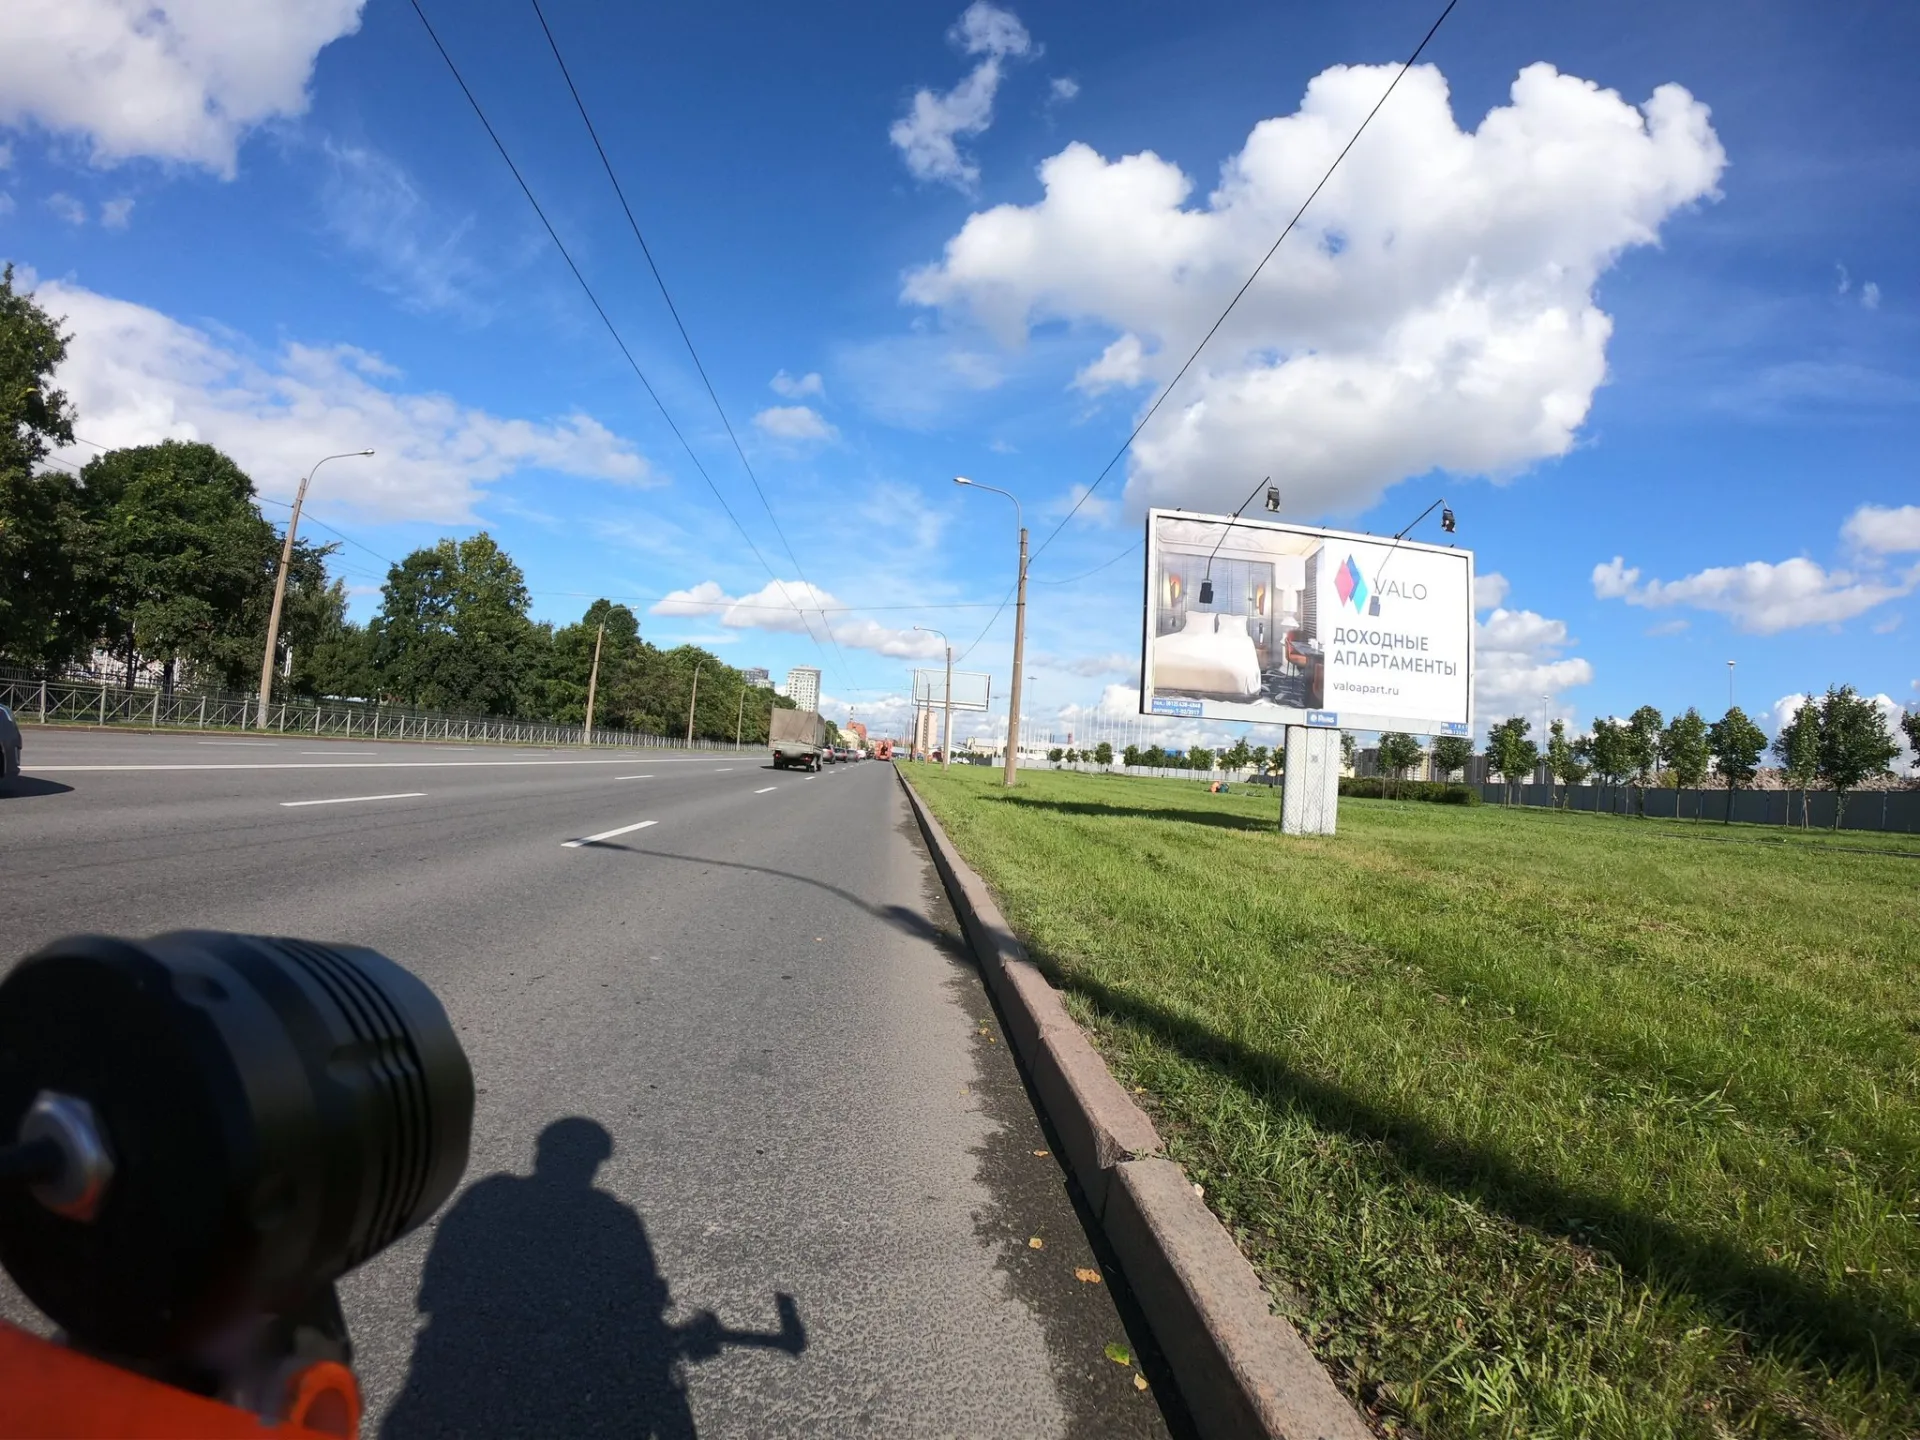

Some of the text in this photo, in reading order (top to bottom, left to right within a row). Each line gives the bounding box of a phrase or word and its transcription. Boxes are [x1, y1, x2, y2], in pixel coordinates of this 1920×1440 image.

[1373, 577, 1427, 600] VALO
[1333, 627, 1429, 651] ДОХОДНЫЕ
[1333, 650, 1457, 676] АПАРТАМЕНТЫ
[1333, 682, 1399, 696] valoapart.ru
